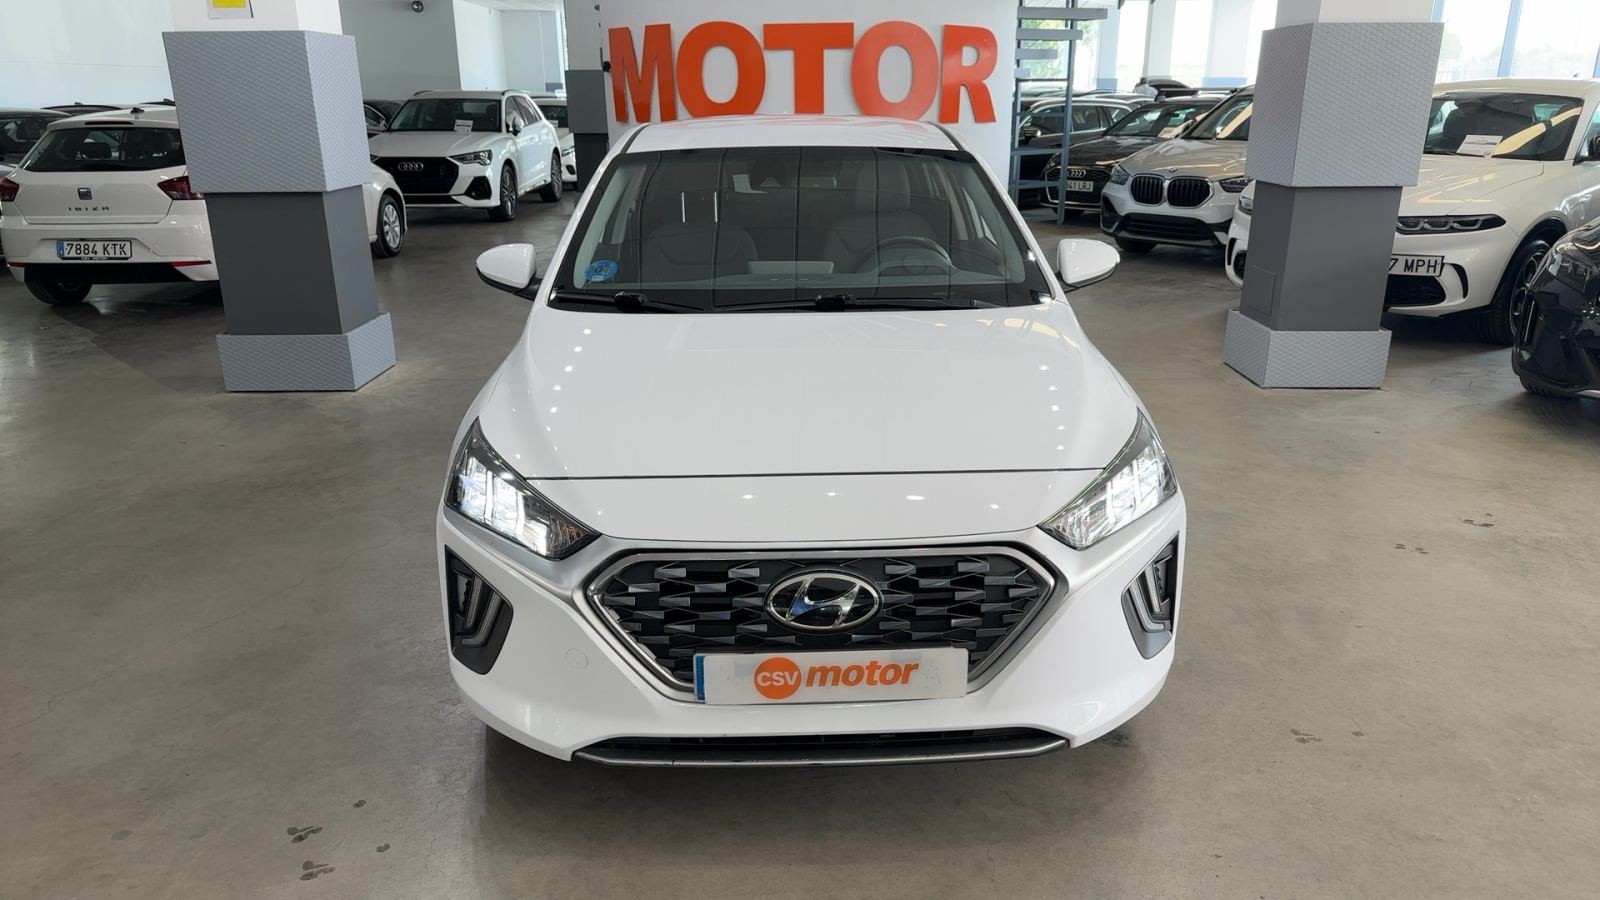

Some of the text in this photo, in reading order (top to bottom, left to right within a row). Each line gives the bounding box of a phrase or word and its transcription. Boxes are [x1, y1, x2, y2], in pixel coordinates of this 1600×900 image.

[608, 20, 997, 123] MOTOR
[1078, 182, 1092, 191] LRJ
[66, 243, 127, 256] 7884 KTK
[1403, 258, 1438, 274] MPH
[757, 660, 920, 688] CSV motor
